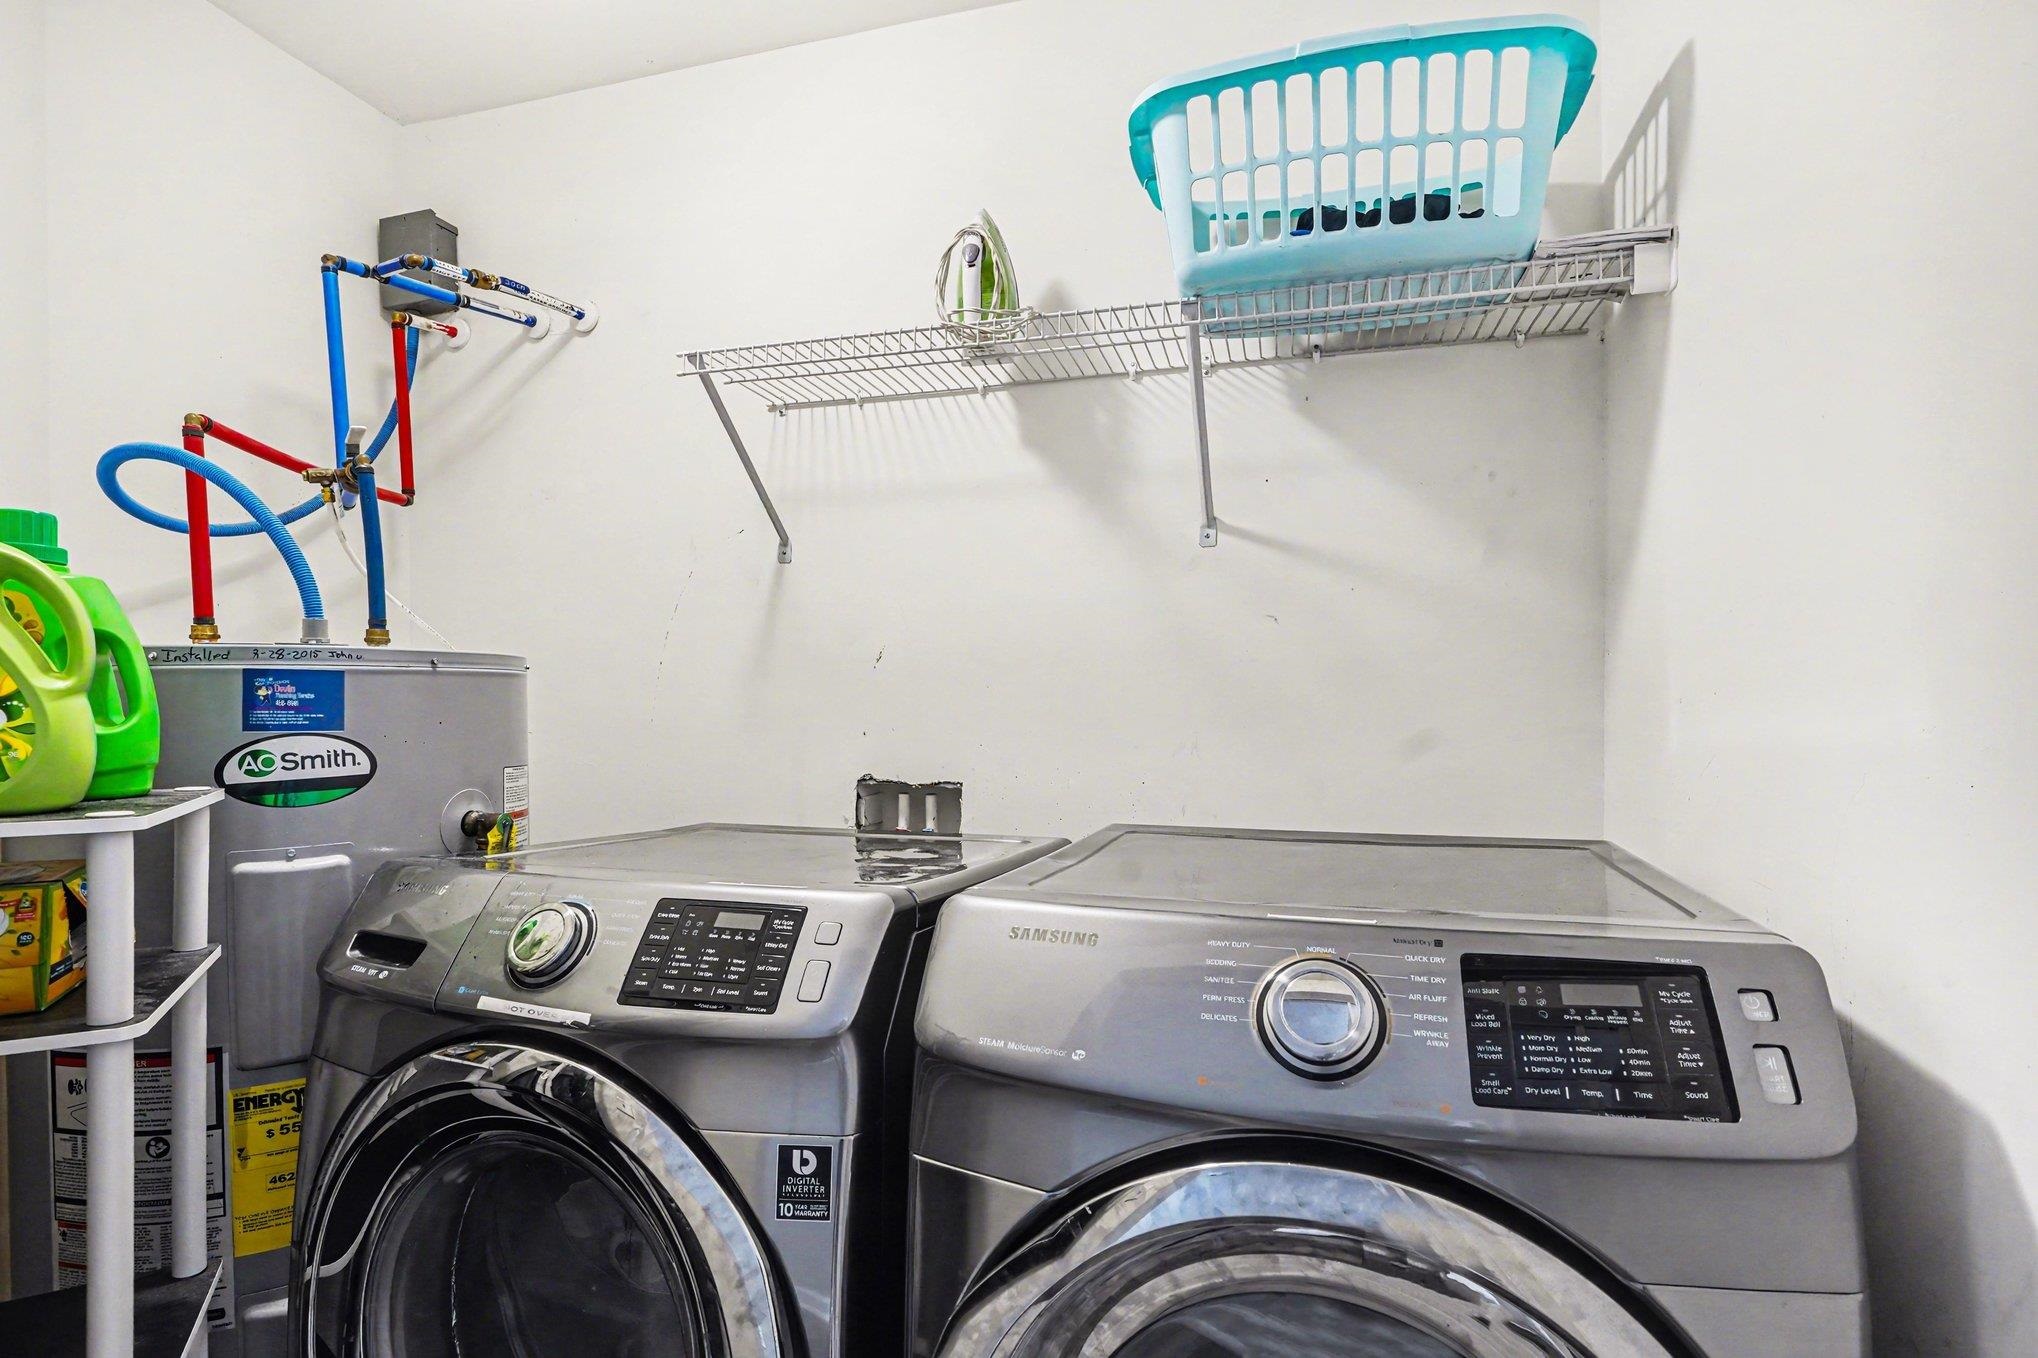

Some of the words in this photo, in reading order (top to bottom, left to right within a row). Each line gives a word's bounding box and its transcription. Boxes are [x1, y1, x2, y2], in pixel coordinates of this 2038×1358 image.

[162, 646, 231, 662] Installed
[1008, 926, 1099, 947] SAMSUNG
[1207, 940, 1231, 948] HEAVY
[1232, 941, 1250, 949] DUTY
[1306, 946, 1337, 954] NORMAL
[1405, 954, 1428, 962] QUICK
[1430, 956, 1446, 964] DRY
[1409, 975, 1429, 983] TIME
[1430, 976, 1447, 984] DRY
[1202, 994, 1222, 1002] PERM
[1223, 995, 1246, 1004] PRESS
[1408, 993, 1422, 1001] AIR
[1423, 994, 1448, 1003] FLUFF
[1200, 1012, 1238, 1022] DELICATES
[1413, 1013, 1448, 1023] REFRESH
[1413, 1029, 1449, 1039] WRINKLE
[978, 1037, 1005, 1048] STEAM
[1426, 1039, 1450, 1048] AWAY
[1476, 1044, 1503, 1052] Wrinkle
[1546, 1045, 1559, 1053] Dry
[1575, 1045, 1603, 1053] Medium
[1477, 1052, 1504, 1060] Prevent
[1531, 1066, 1550, 1074] Damp
[1525, 1086, 1539, 1095] Dry
[1540, 1087, 1561, 1095] Level
[1632, 1091, 1653, 1099] Time
[1684, 1091, 1709, 1099] Sound
[787, 1177, 820, 1185] DIGITAL
[782, 1185, 825, 1194] INVERTER
[779, 1203, 794, 1217] 10
